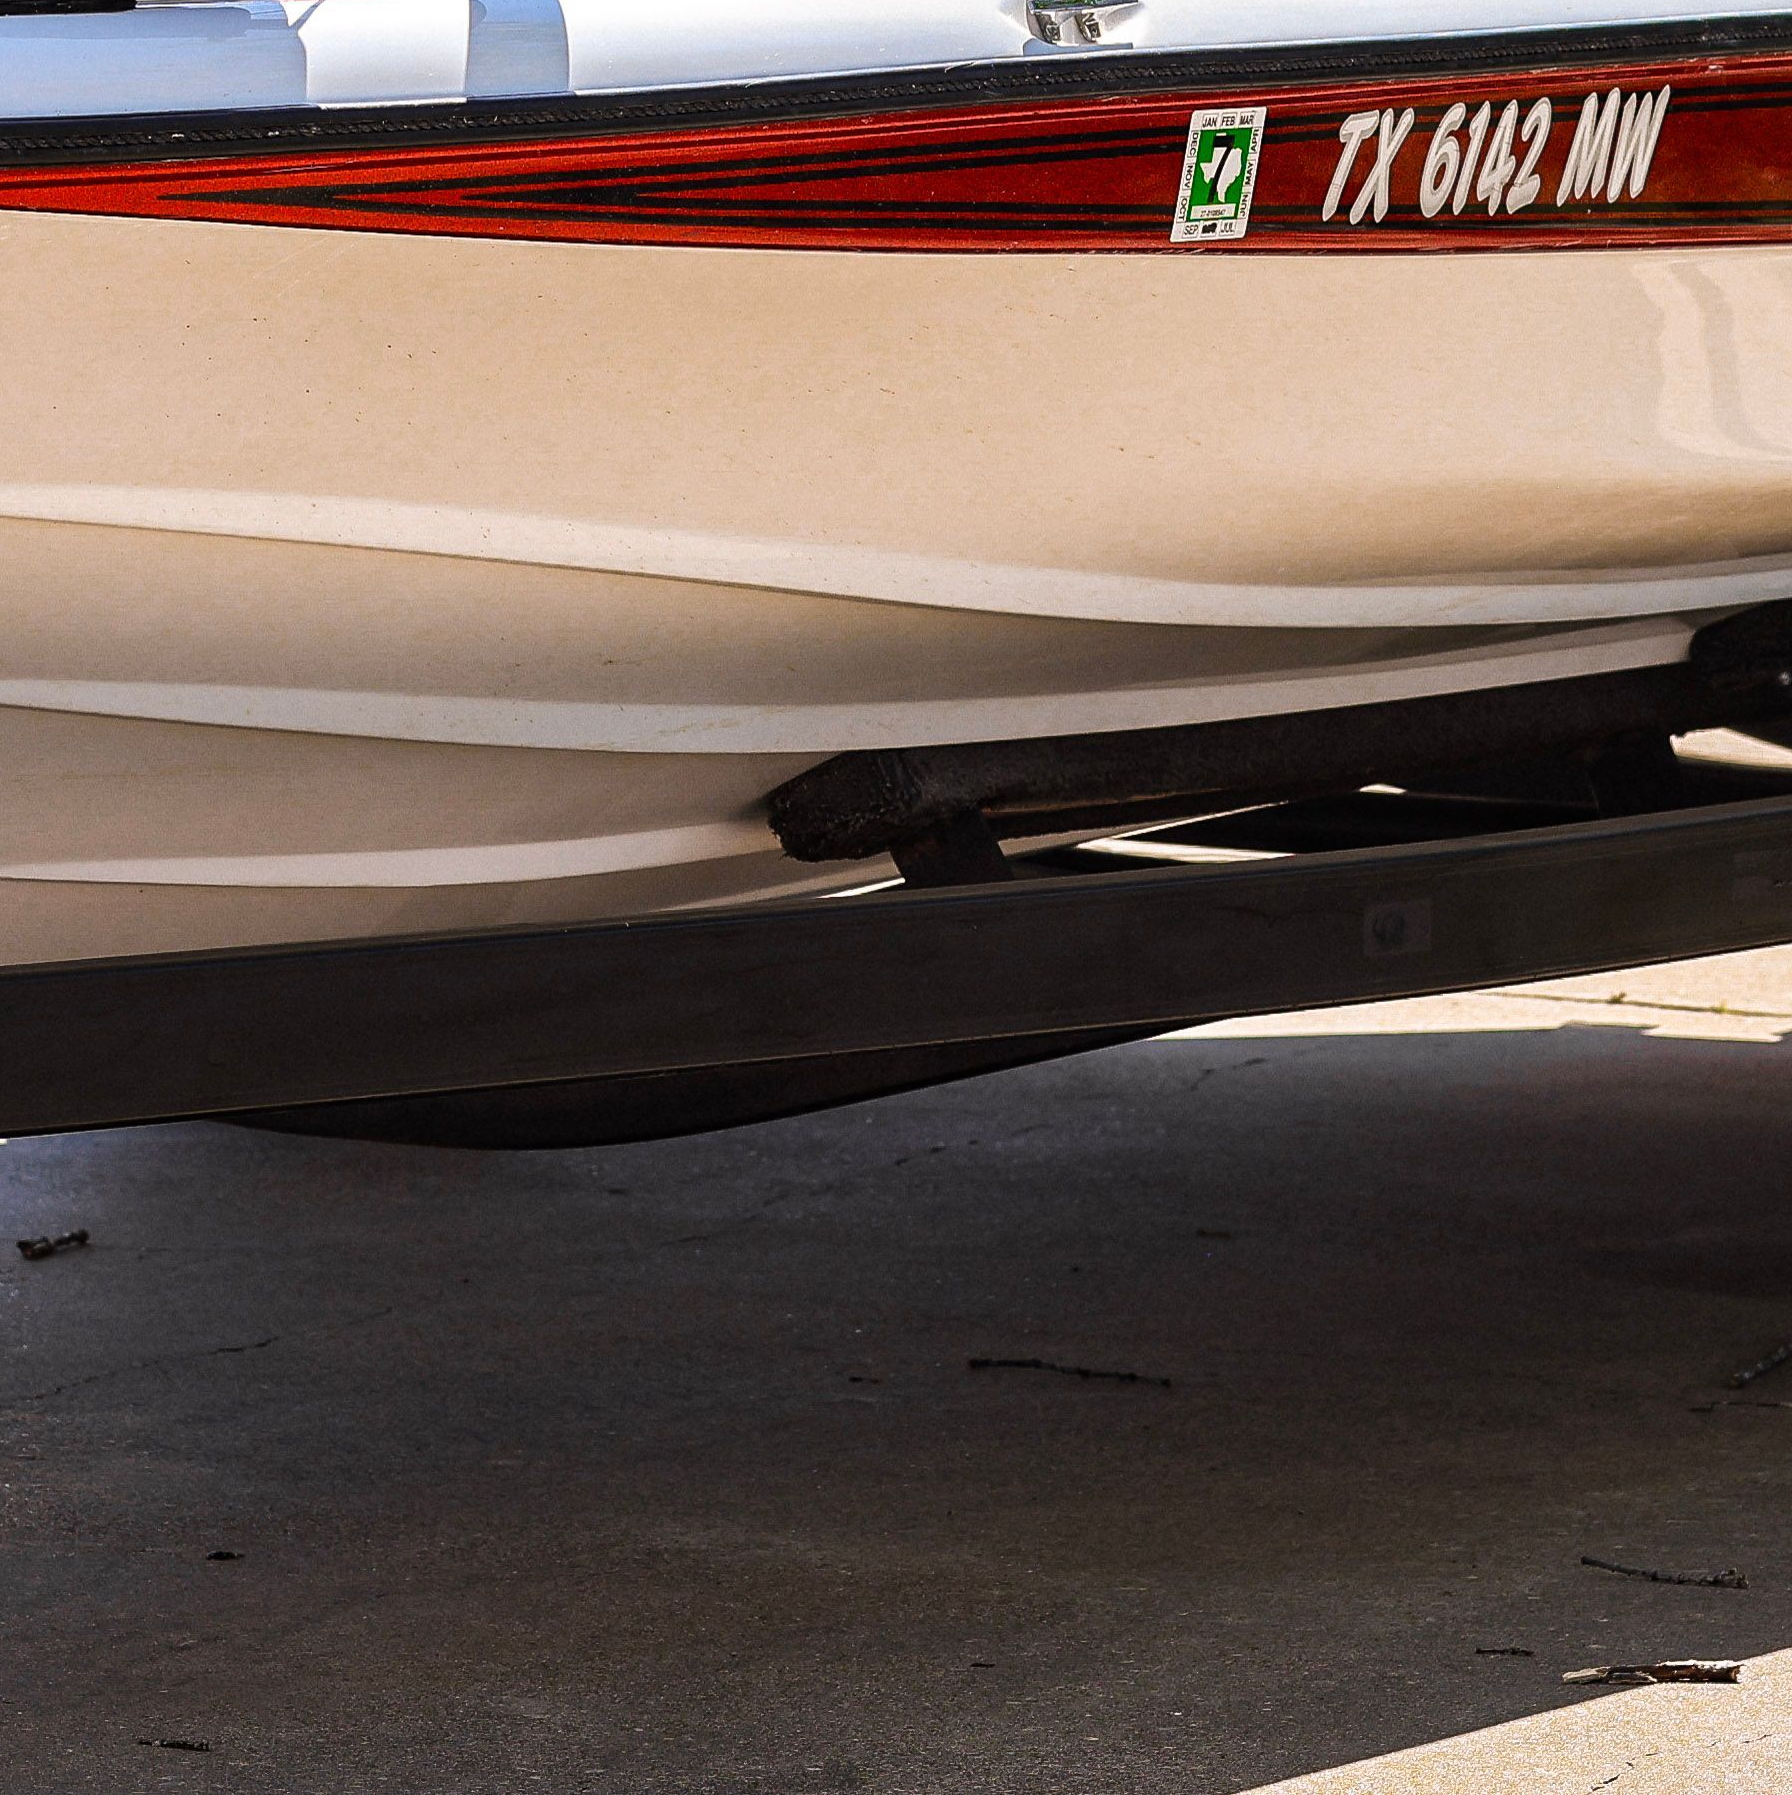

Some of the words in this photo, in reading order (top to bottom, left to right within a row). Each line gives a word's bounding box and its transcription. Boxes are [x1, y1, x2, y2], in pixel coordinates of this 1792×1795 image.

[1202, 116, 1217, 128] JAN
[1221, 116, 1235, 126] FEB
[1239, 114, 1255, 125] MAR
[1189, 132, 1199, 156] DEC
[1322, 107, 1414, 225] TX
[1419, 97, 1552, 218] 6142
[1557, 84, 1670, 207] MW
[1184, 165, 1194, 189] NOV
[1245, 162, 1254, 186] MAY
[1178, 197, 1188, 221] OCT
[1240, 194, 1249, 217] JUN
[1184, 224, 1199, 236] SEP
